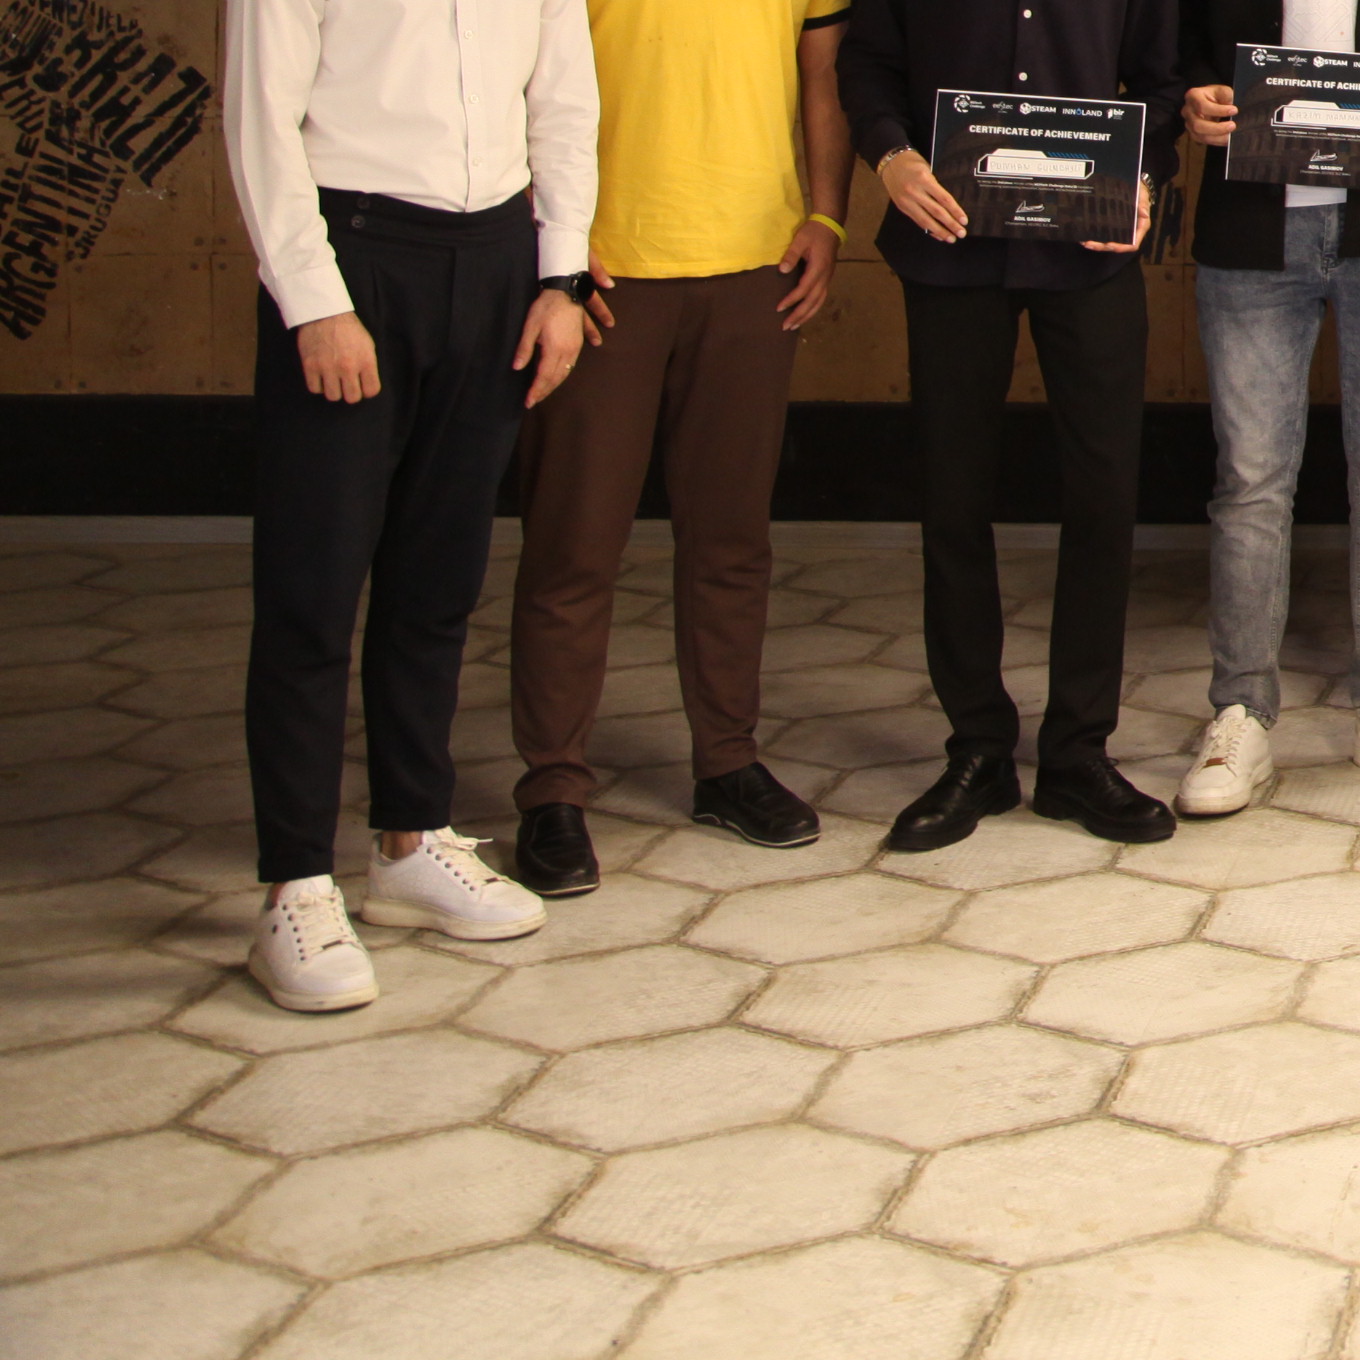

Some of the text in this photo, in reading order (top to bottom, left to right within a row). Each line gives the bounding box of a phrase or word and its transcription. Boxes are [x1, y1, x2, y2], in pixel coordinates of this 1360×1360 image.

[1266, 77, 1323, 89] CERTIFICATE
[1324, 81, 1336, 89] OF
[1062, 108, 1102, 117] INNOLAND
[969, 124, 1111, 141] CERTIFICATE OF ACHIEVEMENT
